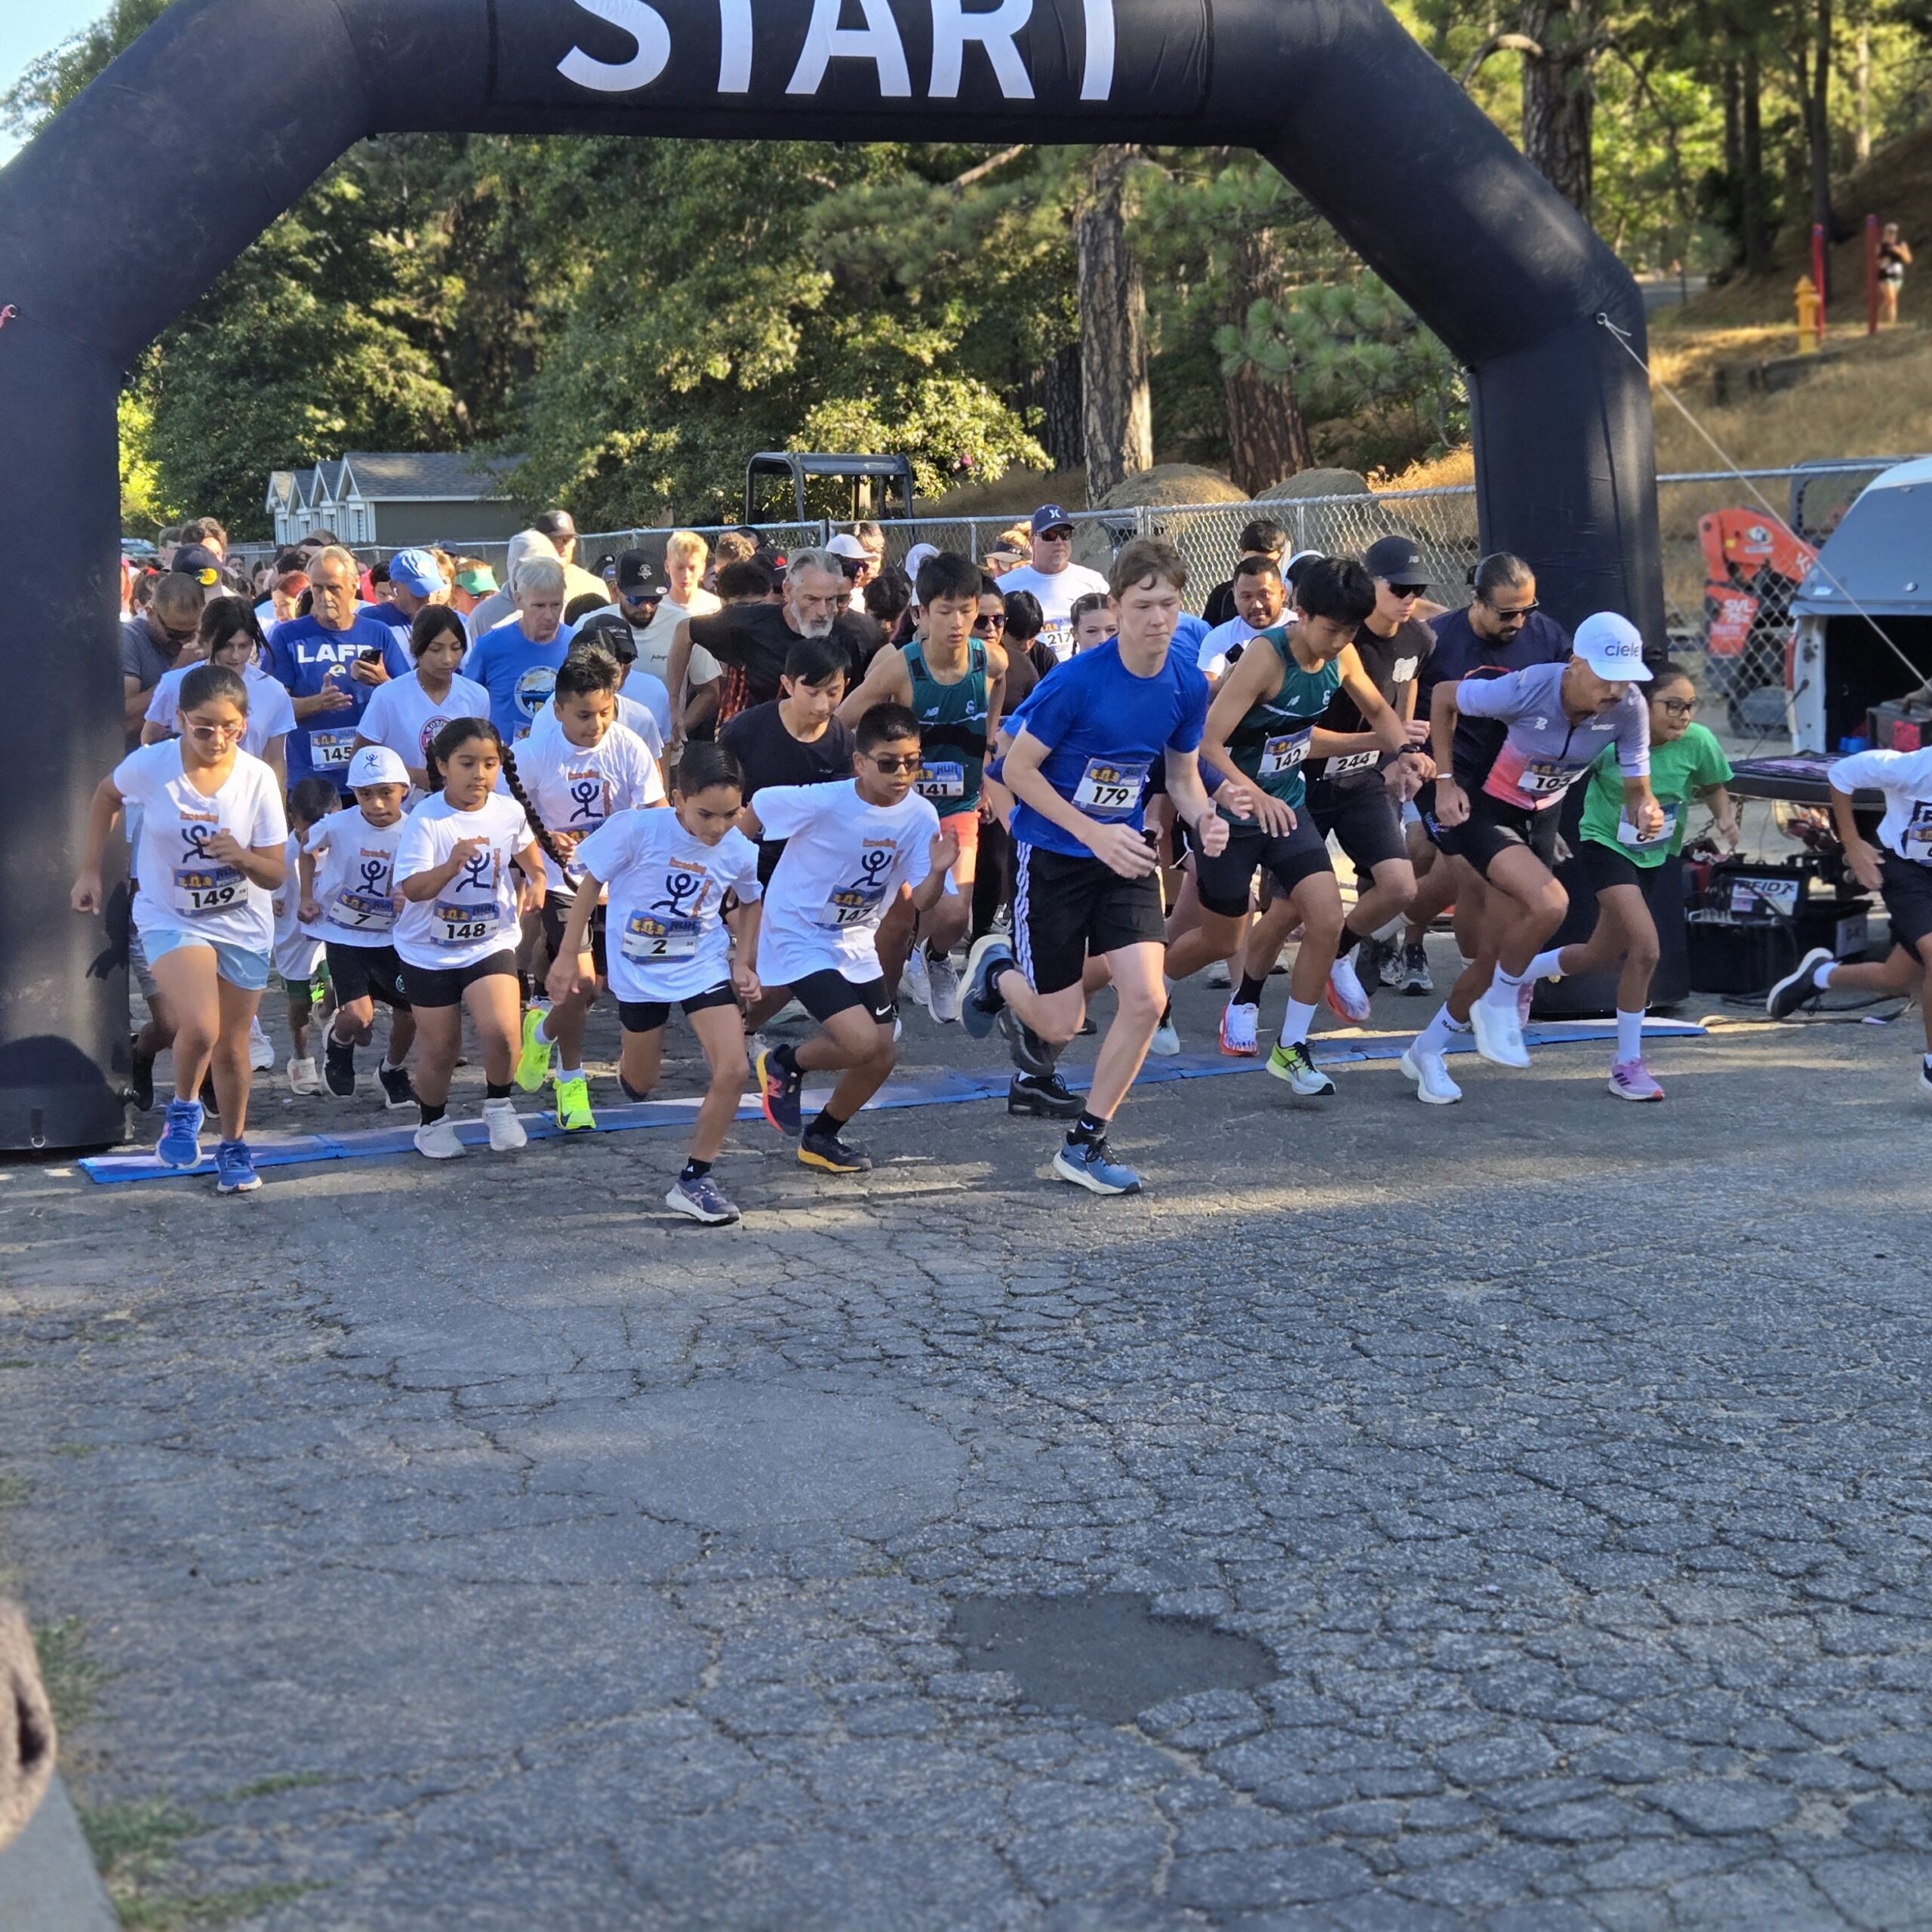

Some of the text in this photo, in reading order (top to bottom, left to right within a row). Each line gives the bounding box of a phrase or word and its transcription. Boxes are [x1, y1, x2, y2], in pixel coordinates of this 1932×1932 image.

[1048, 632, 1071, 645] 217
[1604, 641, 1639, 657] ciele
[1275, 749, 1301, 771] 142
[1337, 753, 1370, 771] 244
[937, 764, 958, 775] RUN
[917, 783, 948, 795] 141
[1093, 786, 1129, 806] 179
[191, 887, 235, 909] 149
[354, 914, 371, 925] 7
[837, 908, 874, 924] 147
[447, 923, 486, 940] 148
[651, 940, 667, 955] 2
